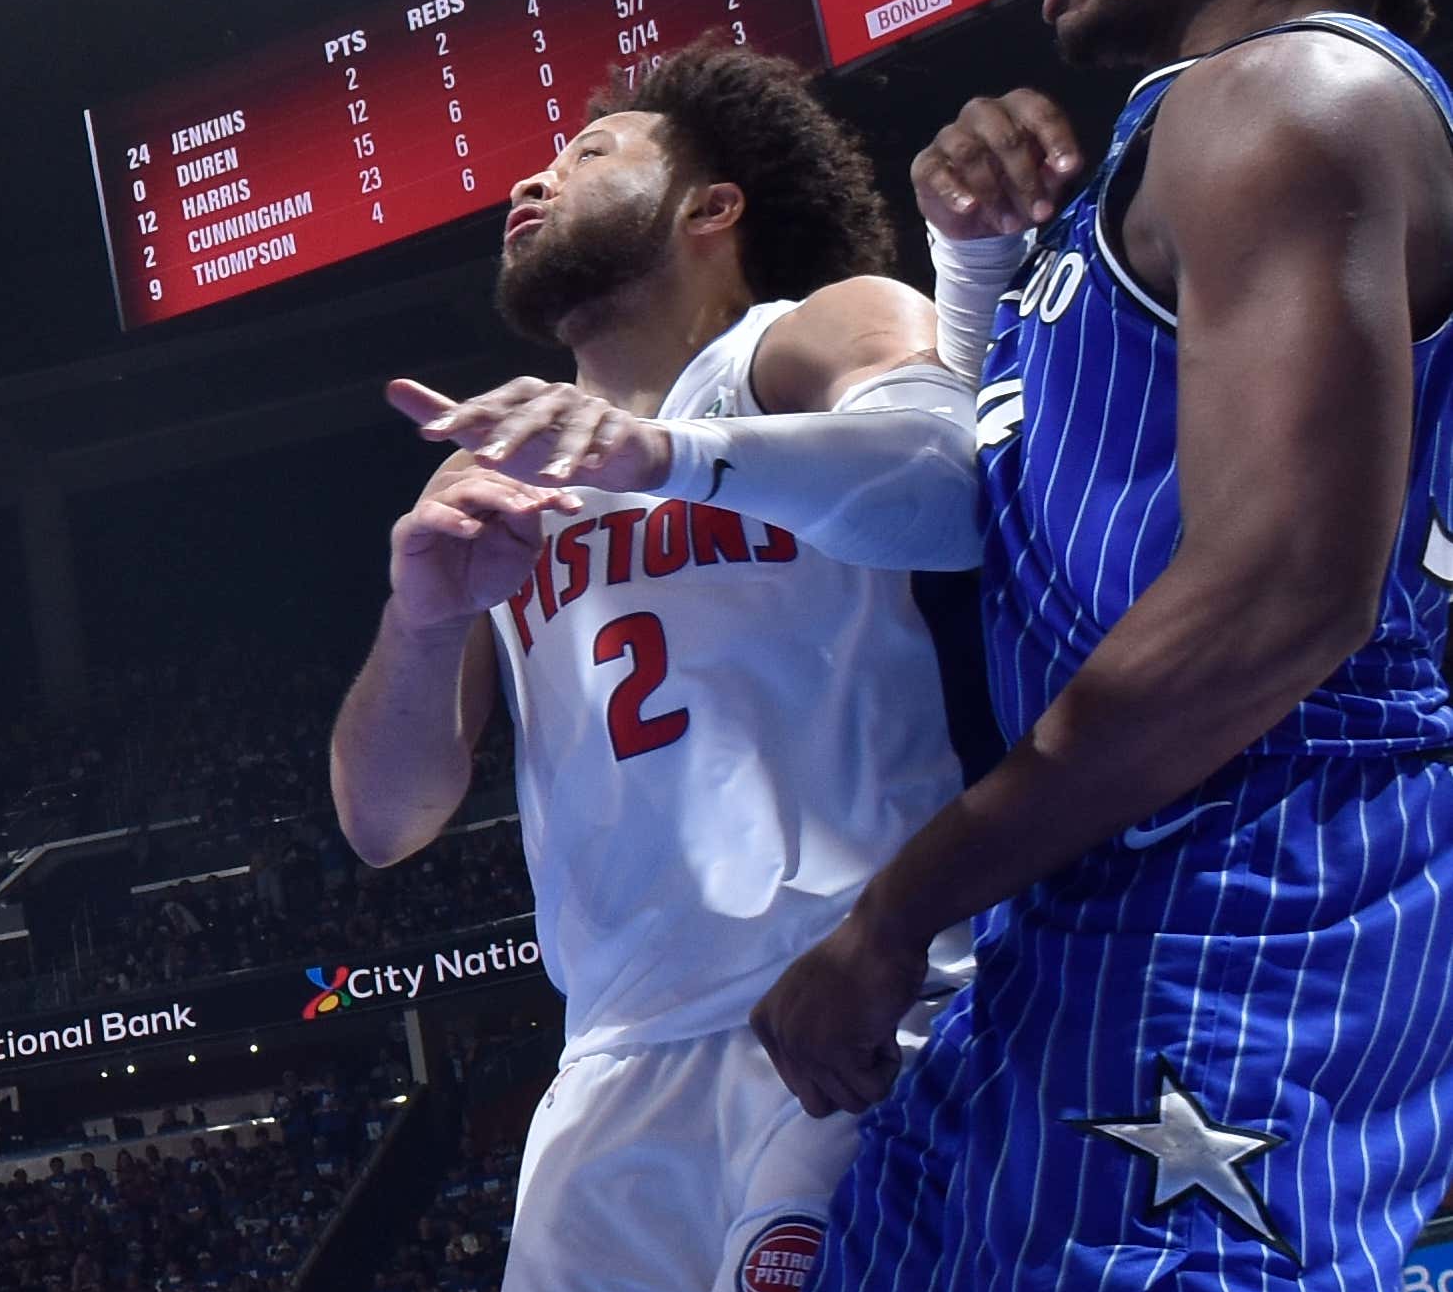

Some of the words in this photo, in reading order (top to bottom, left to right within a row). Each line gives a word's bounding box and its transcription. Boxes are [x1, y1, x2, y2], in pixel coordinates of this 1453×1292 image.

[324, 30, 367, 64] PTS
[617, 19, 659, 55] 6/14
[170, 110, 247, 156] JENKINS
[176, 147, 239, 188] DUREN
[181, 178, 252, 221] HARRIS
[187, 190, 314, 253] CUNNINGHAM
[192, 234, 298, 288] THOMPSON
[594, 611, 689, 762] 2
[346, 965, 424, 1001] City
[435, 938, 539, 982] Natio
[102, 1002, 197, 1041] Bank
[754, 1267, 806, 1287] PISTO
[758, 1250, 815, 1271] DETRO
